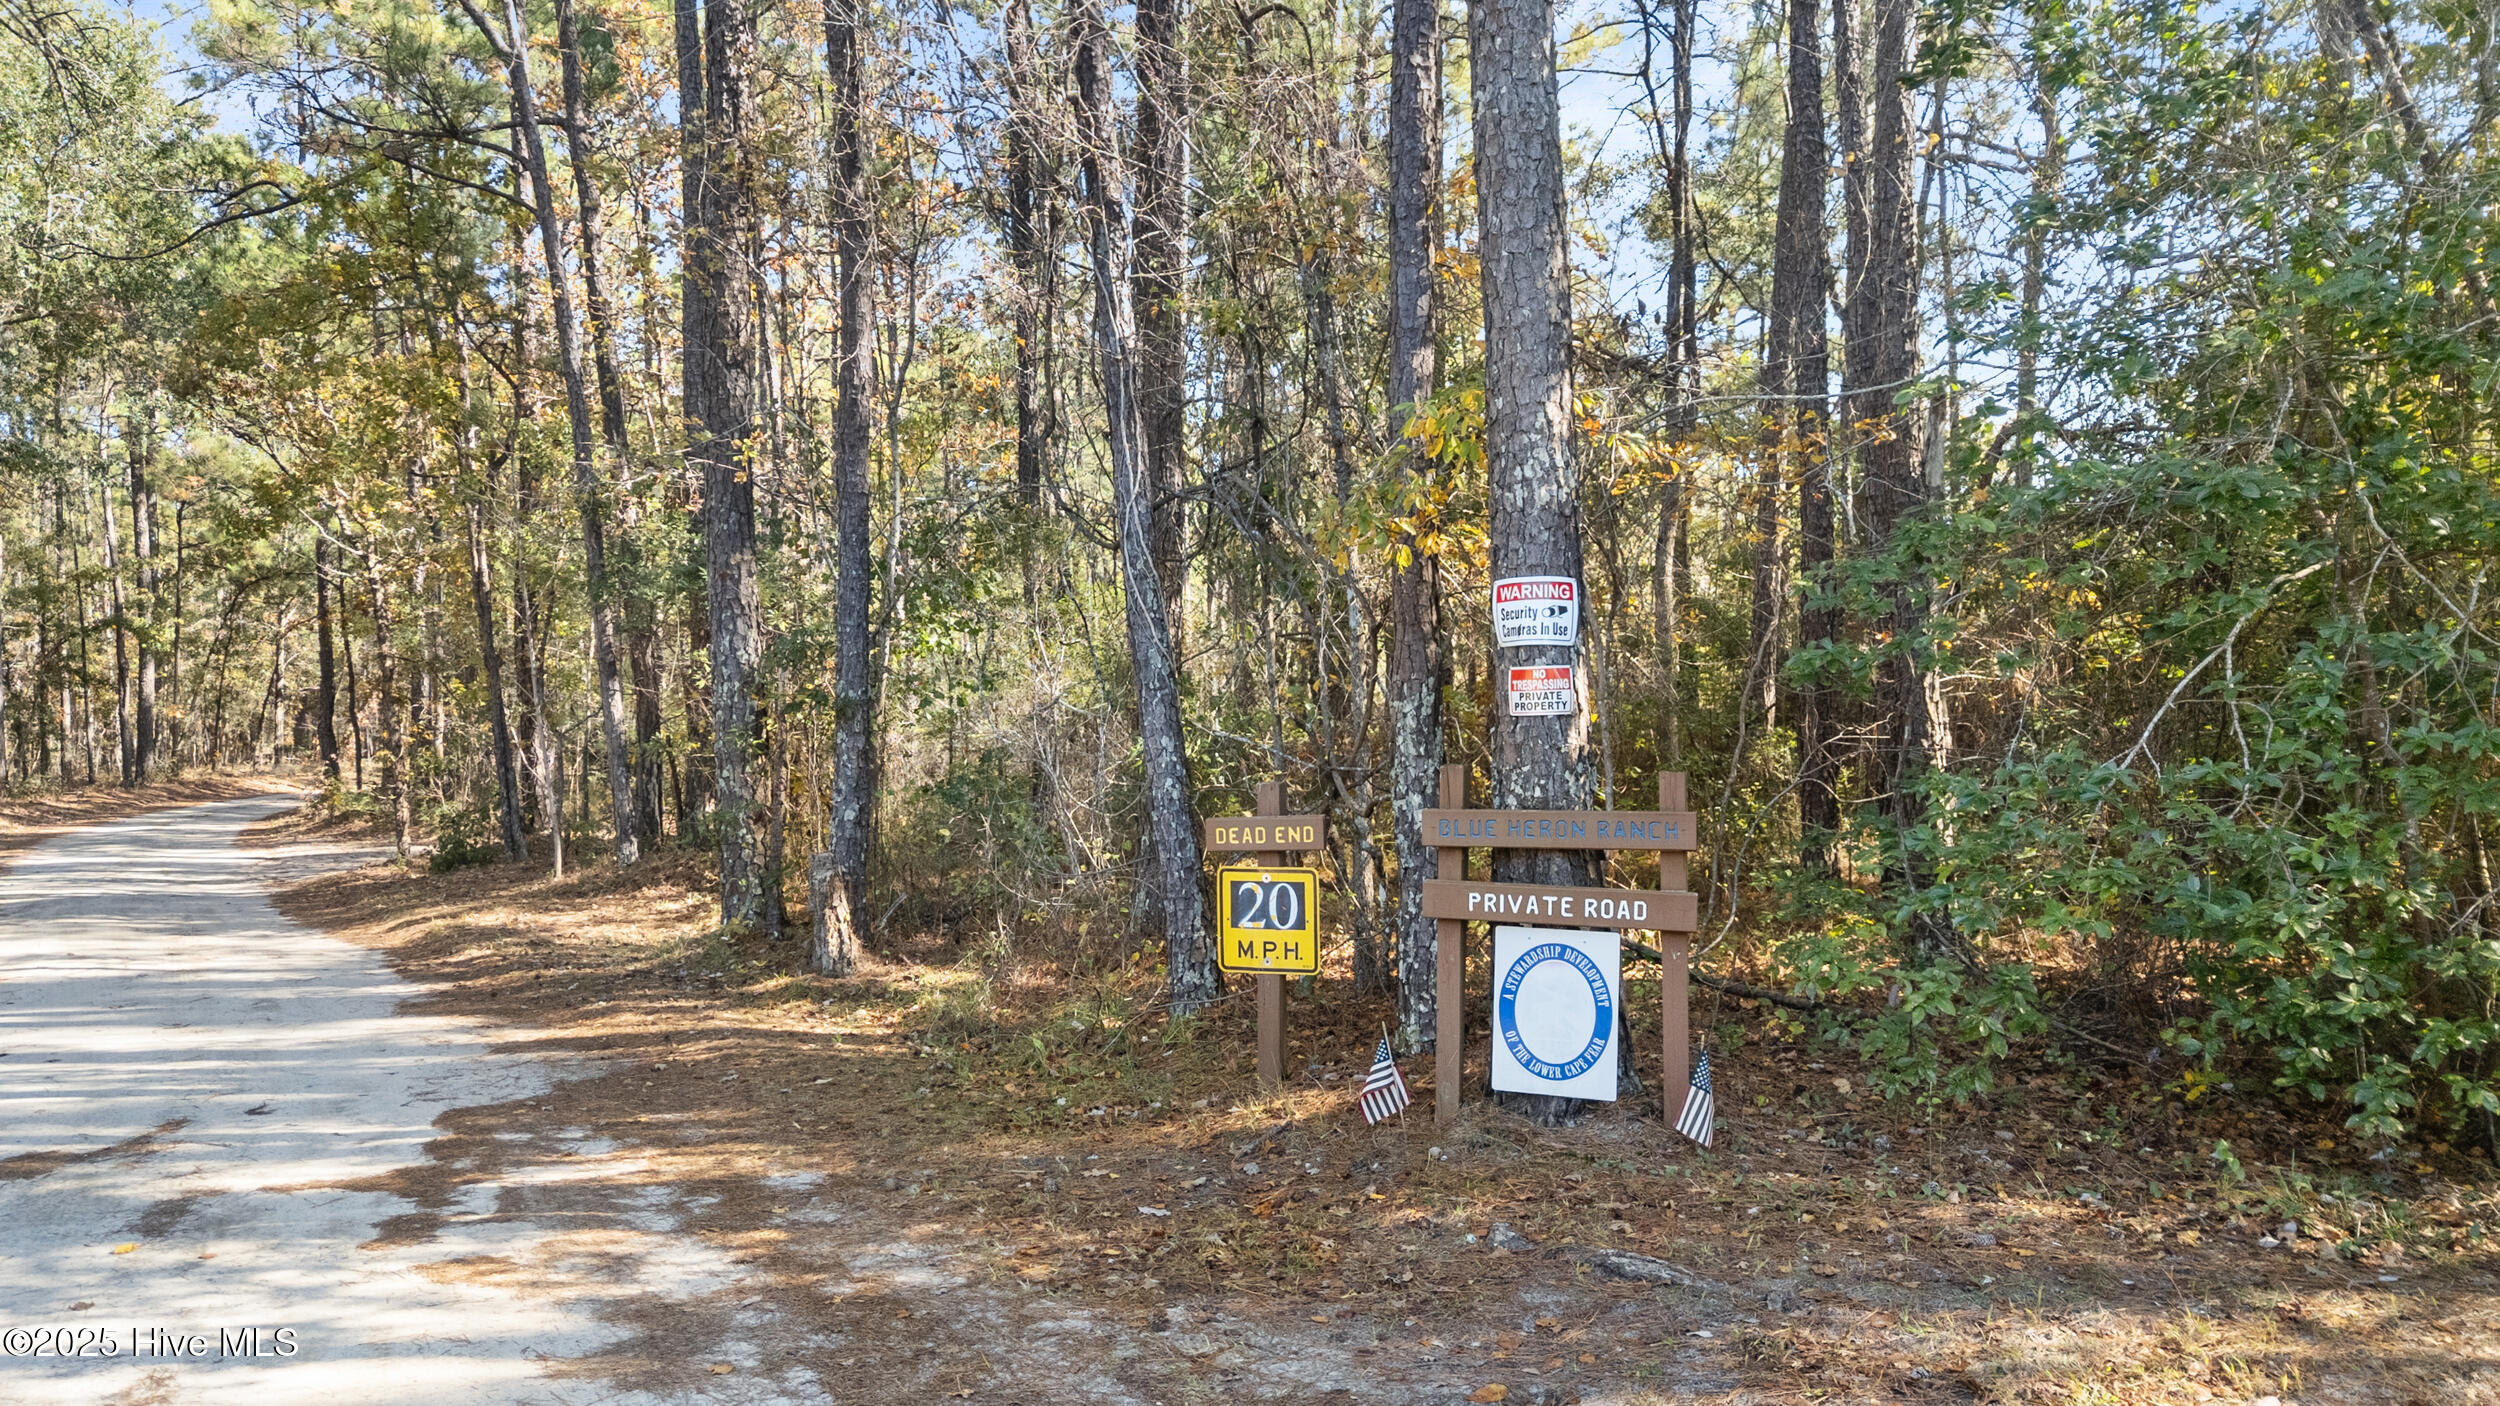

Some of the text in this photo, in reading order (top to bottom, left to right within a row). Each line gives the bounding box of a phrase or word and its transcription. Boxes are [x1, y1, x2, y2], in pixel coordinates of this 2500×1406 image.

[1500, 584, 1570, 601] WARNING
[1501, 606, 1538, 621] Security
[1541, 622, 1550, 635] In
[1553, 622, 1568, 636] Use
[1532, 669, 1546, 679] NO
[1512, 679, 1570, 691] TRESPASSING
[1519, 691, 1562, 701] PRIVATE
[1514, 701, 1568, 711] PROPERTY
[1215, 826, 1314, 844] DEAD END
[1439, 819, 1679, 841] BLUE HERON RANCH
[1238, 882, 1298, 930] 20
[1468, 892, 1648, 921] PRIVATE ROAD
[1238, 939, 1303, 961] M.P.H.
[1505, 945, 1561, 992] STEWARDSHIP
[1564, 948, 1610, 1007] DEVELOPMENT
[1505, 1030, 1605, 1078] OF THE LOWER CAPE FEAR
